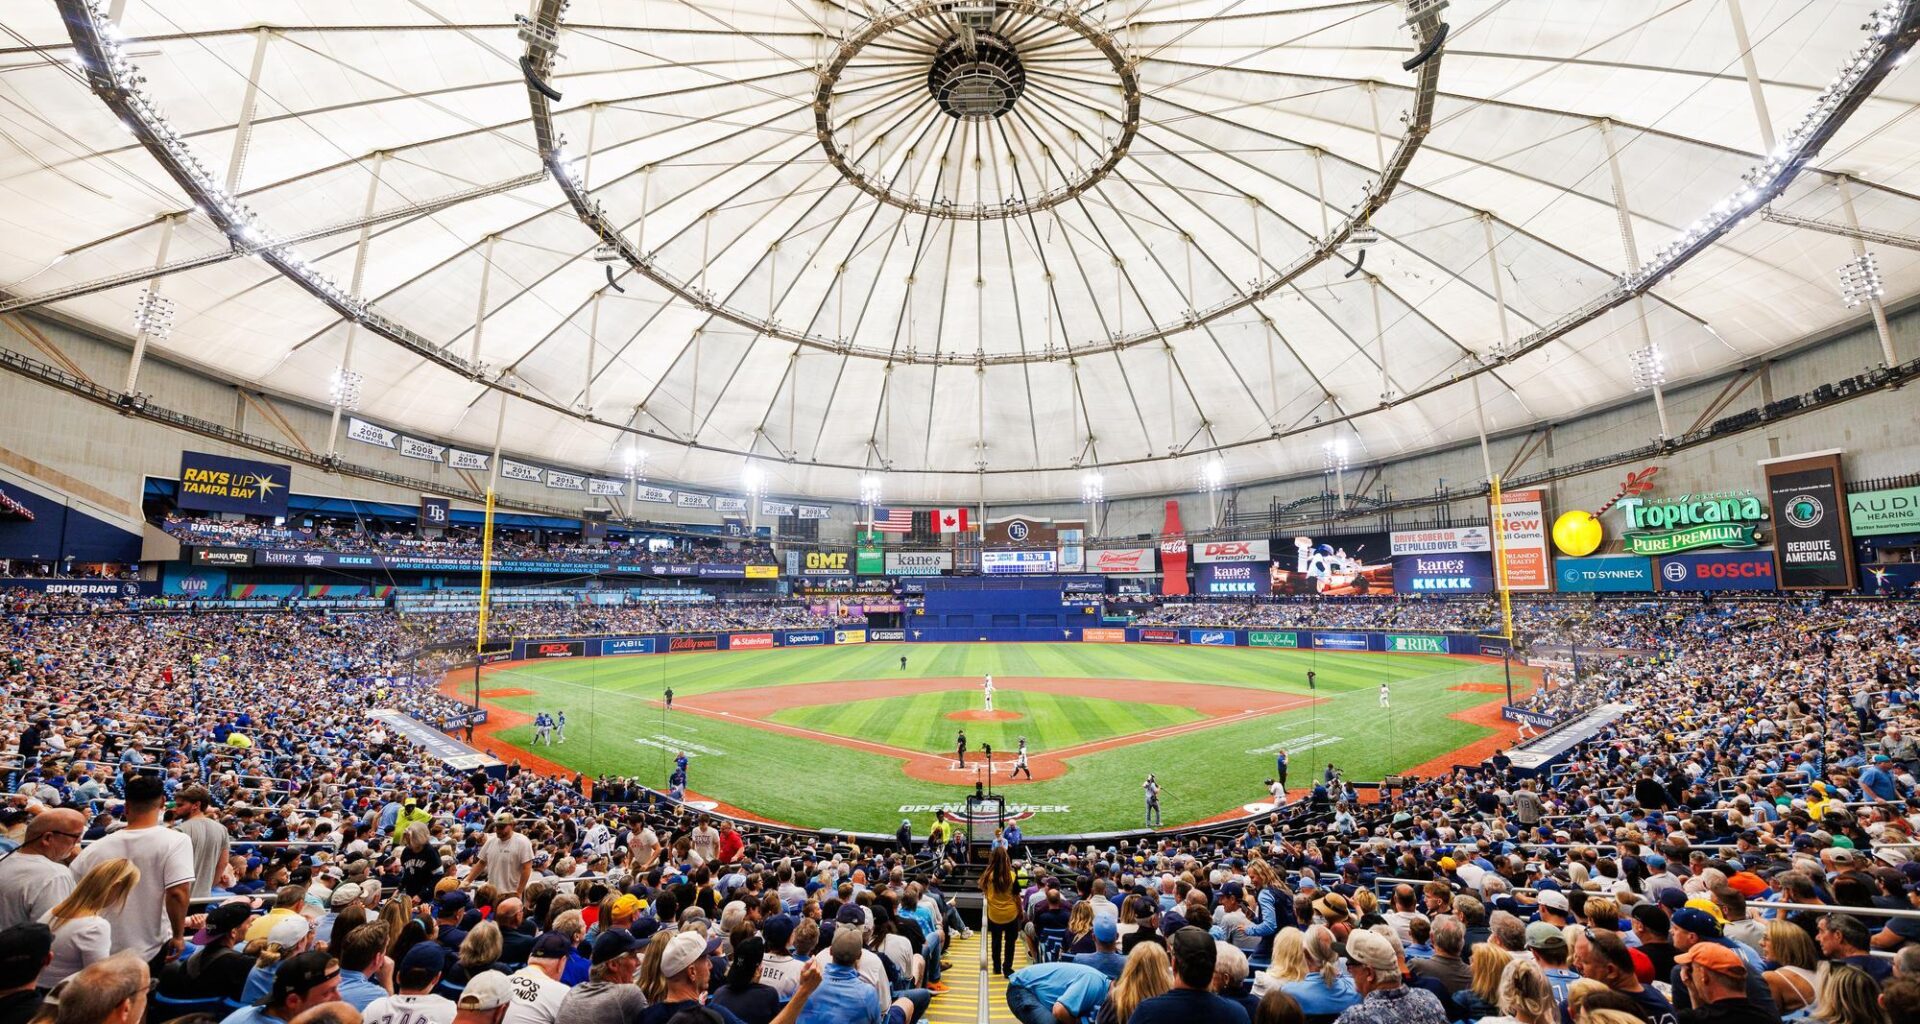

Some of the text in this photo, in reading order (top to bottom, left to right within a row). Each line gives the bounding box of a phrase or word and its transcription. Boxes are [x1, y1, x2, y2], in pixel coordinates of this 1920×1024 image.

[353, 432, 388, 446] CHAMPIONS
[360, 428, 384, 440] 2008
[404, 449, 438, 460] CHAMPIONS
[411, 444, 433, 454] 2008
[458, 456, 477, 464] 2010
[512, 466, 531, 475] 2011
[184, 468, 254, 487] RAYS UP
[183, 482, 256, 499] TAMPA BAY
[427, 504, 445, 521] TB
[1616, 494, 1762, 530] Tropicana
[1867, 511, 1914, 521] HEARING
[1012, 524, 1025, 538] TB
[1495, 519, 1539, 532] New
[1395, 532, 1456, 543] DRIVE SOBER OR
[1633, 527, 1743, 552] PURE PREMIUM
[1205, 543, 1252, 556] DEX
[1394, 543, 1407, 552] GET
[1408, 542, 1437, 551] PULLED
[1437, 541, 1458, 549] OVER
[1787, 540, 1831, 552] REROUTE
[807, 552, 848, 569] GMF
[1785, 551, 1836, 563] AMERICAS
[1417, 559, 1464, 571] kane's
[1695, 562, 1772, 578] BOSCH
[1213, 566, 1250, 577] kane's
[1582, 570, 1644, 580] TD SYNNEX
[46, 584, 118, 594] SOMOS RAYS
[181, 580, 208, 590] VIVA
[1210, 583, 1256, 592] KKKKK
[1413, 578, 1472, 589] KKKKK
[789, 635, 817, 643] Spectrum
[1410, 637, 1438, 651] RIPA
[538, 644, 570, 654] DEX
[1005, 804, 1071, 813] WEEK
